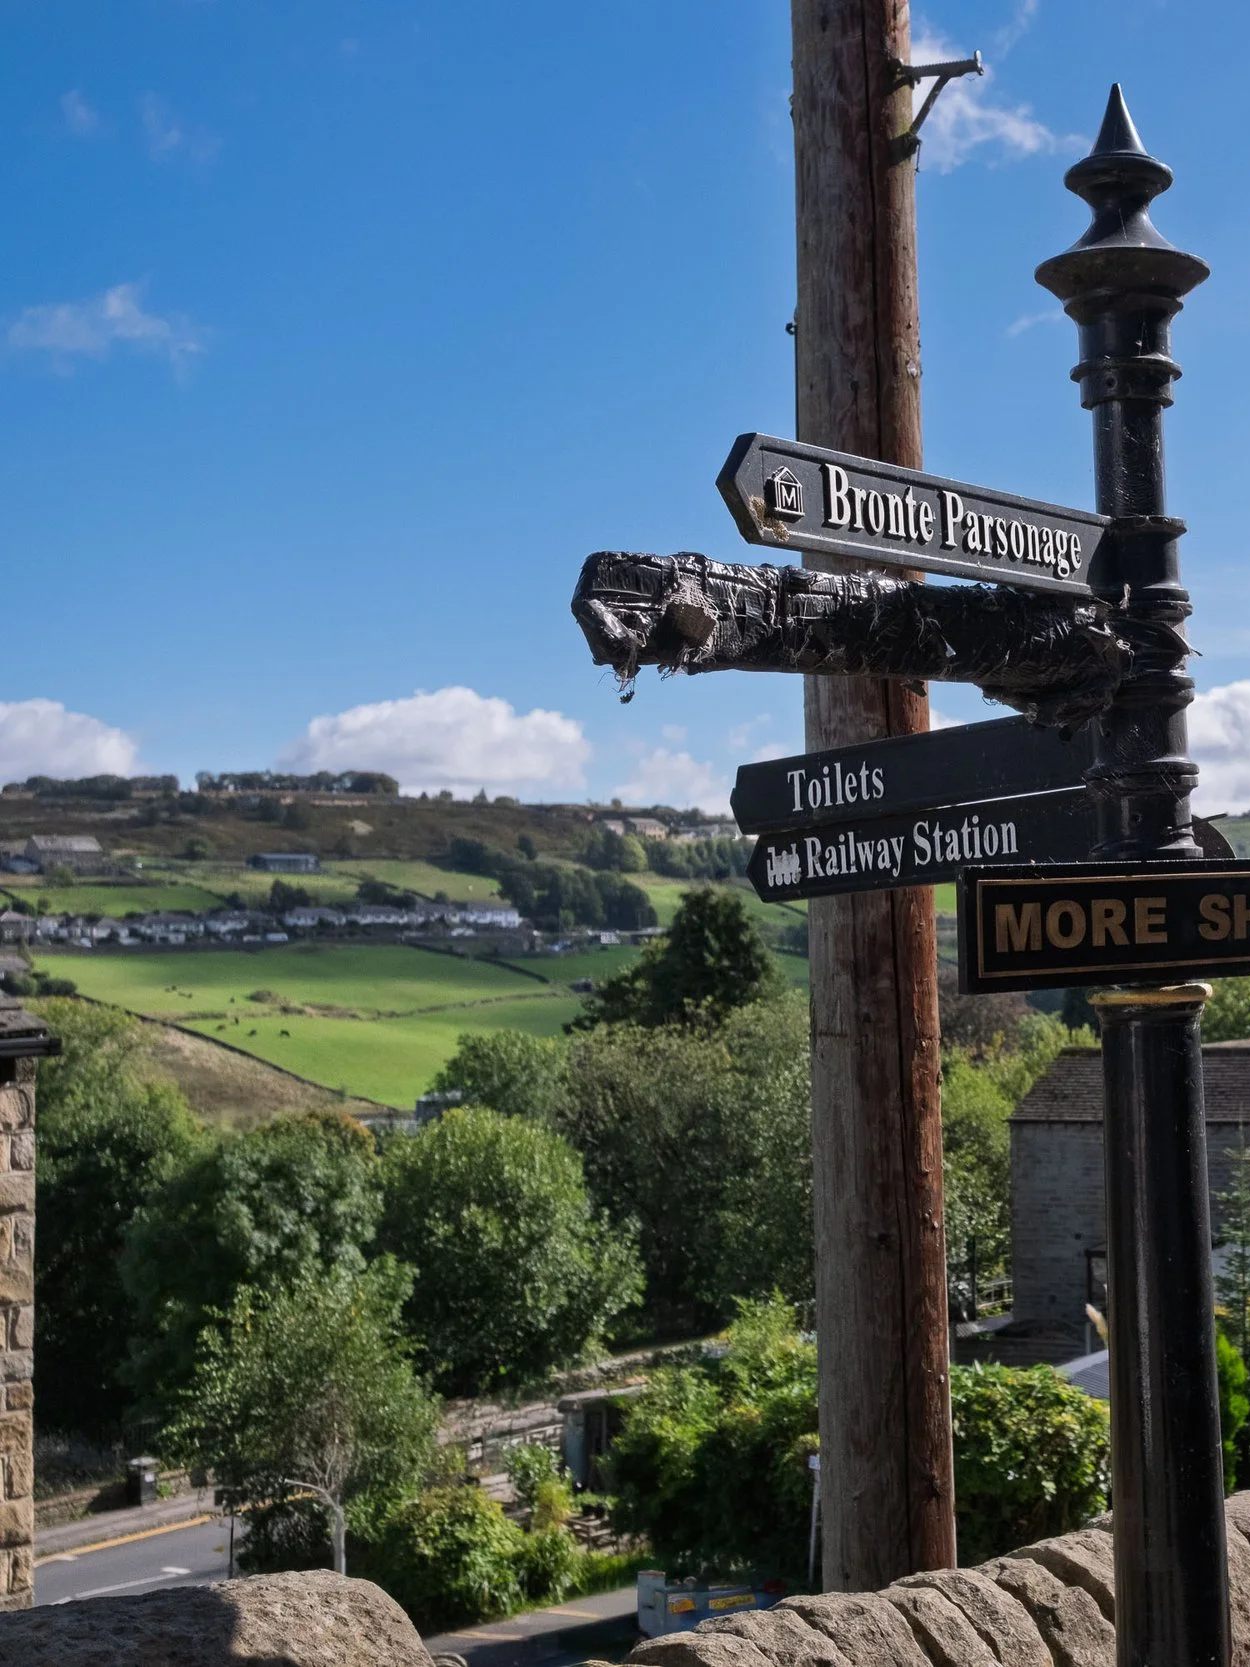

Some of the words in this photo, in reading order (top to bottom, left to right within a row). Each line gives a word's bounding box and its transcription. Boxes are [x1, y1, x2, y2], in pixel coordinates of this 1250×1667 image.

[781, 485, 797, 509] M
[824, 463, 934, 542] Bronte
[942, 490, 1082, 578] Parsonage
[788, 761, 885, 812] Toilets
[804, 831, 905, 879] Railway
[913, 815, 1019, 867] Station
[994, 896, 1169, 953] MORE
